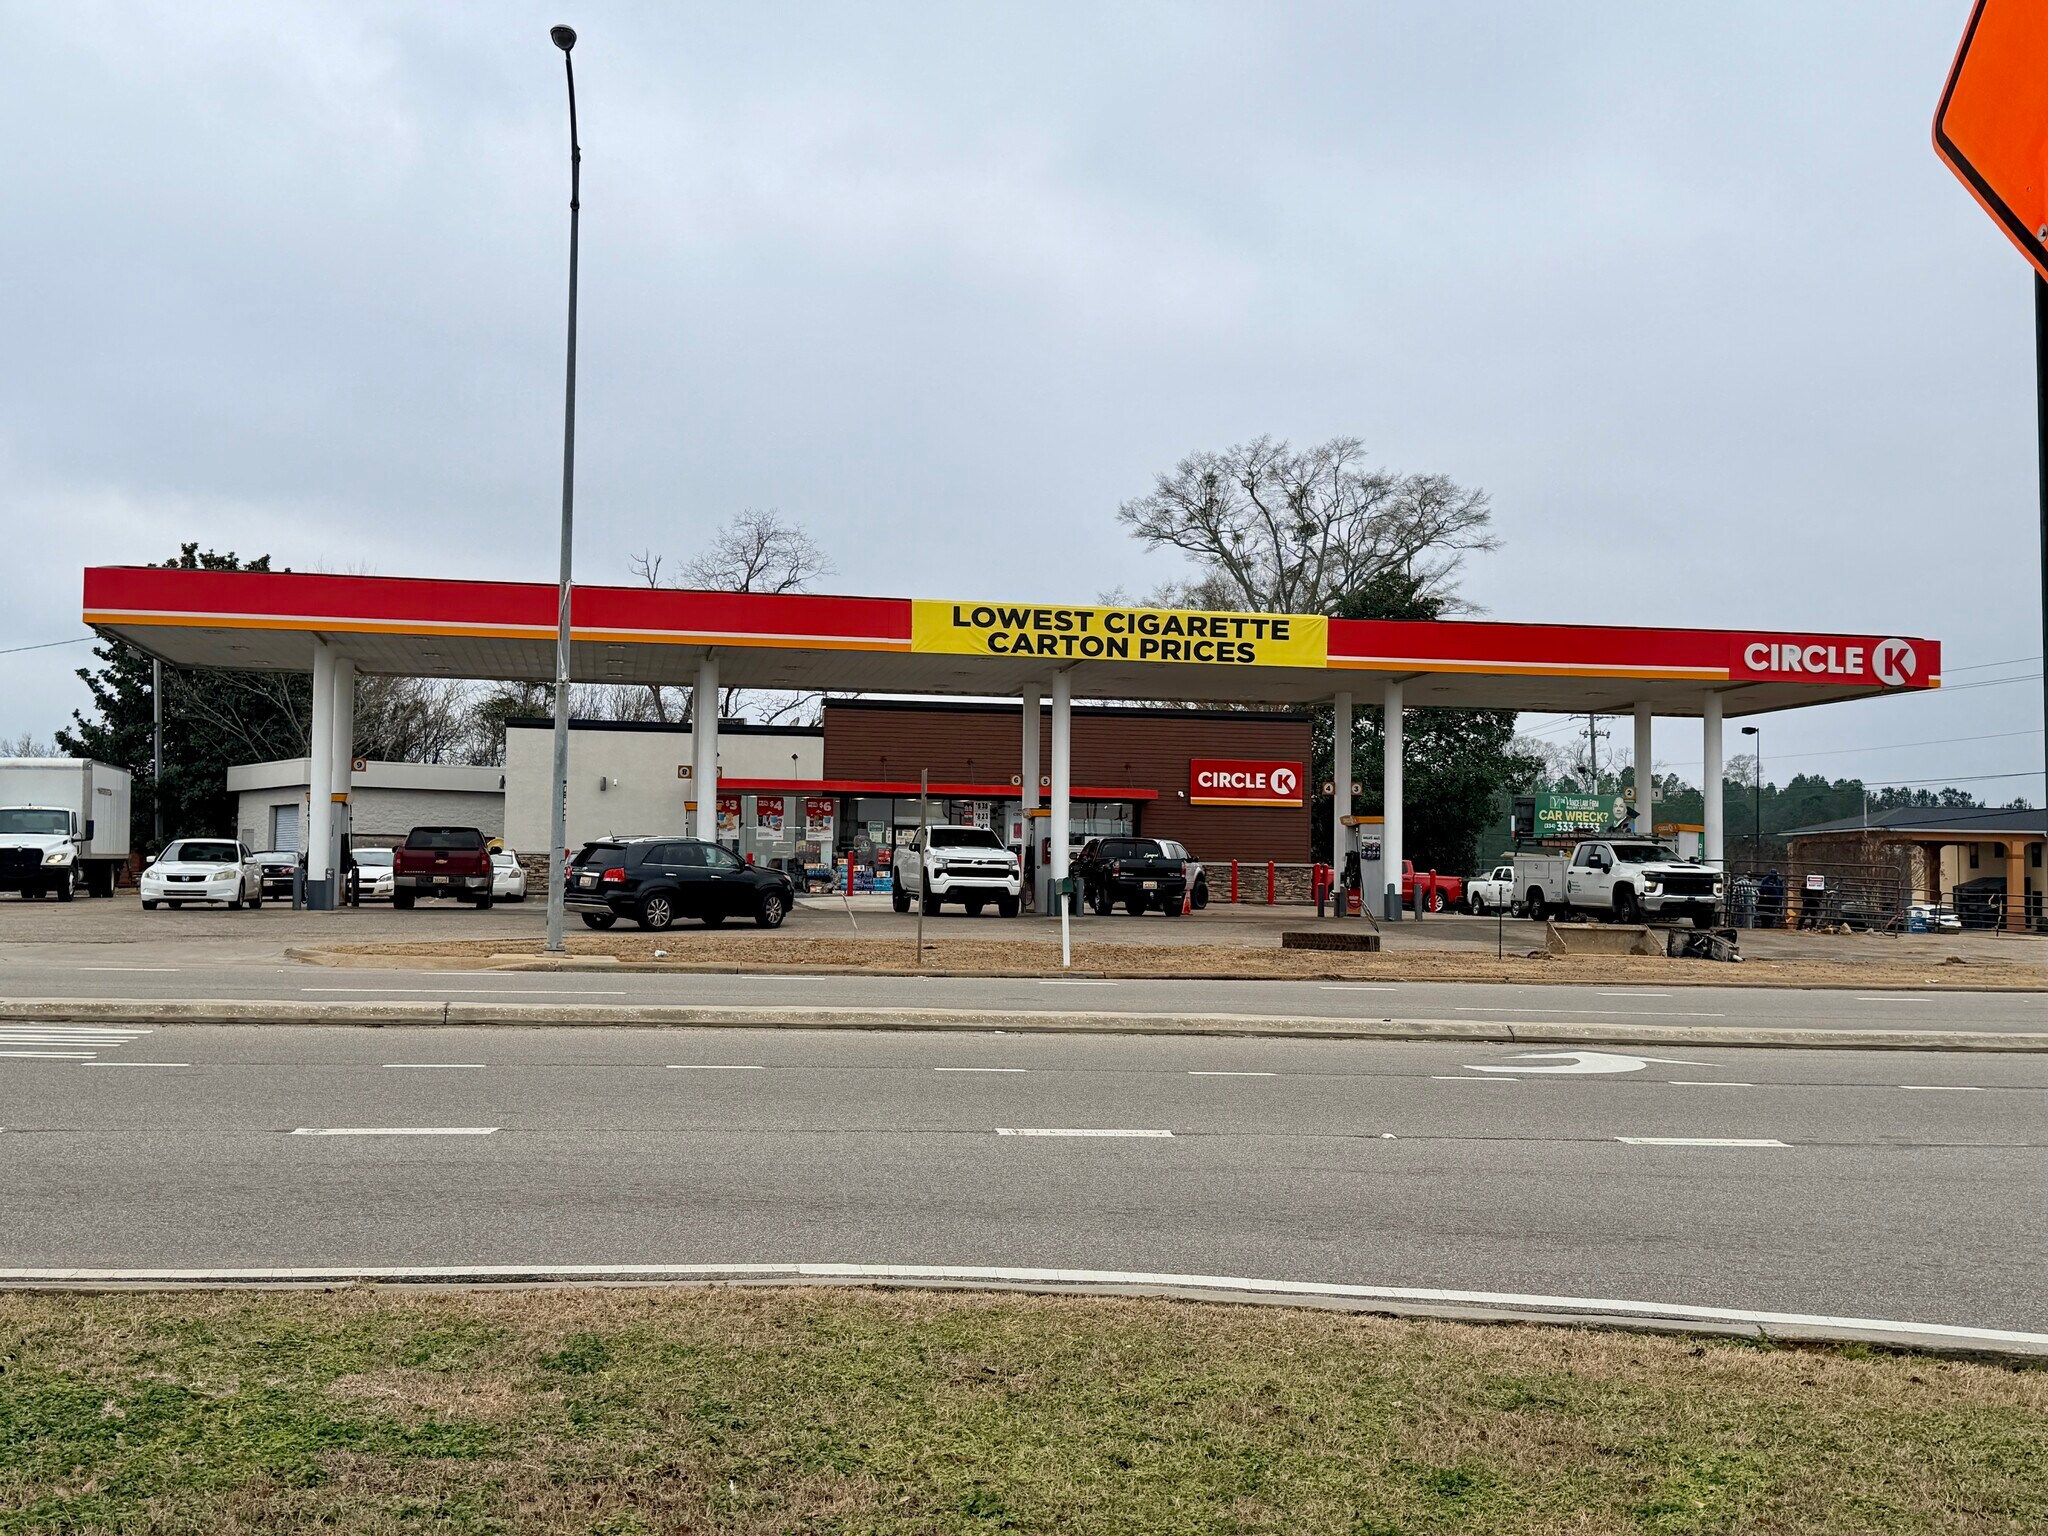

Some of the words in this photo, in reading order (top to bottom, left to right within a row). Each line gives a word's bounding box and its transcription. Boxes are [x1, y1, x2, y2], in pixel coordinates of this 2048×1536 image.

[952, 605, 1095, 632] LOWEST
[1104, 612, 1290, 641] CIGARETTE
[987, 632, 1129, 658] CARTON
[1139, 639, 1256, 664] PRICES
[1744, 642, 1864, 675] CIRCLE
[1878, 642, 1914, 686] K
[1198, 771, 1267, 789] CIRCLE
[1274, 771, 1294, 794] K
[1539, 810, 1563, 821] CAR
[1565, 810, 1609, 823] WRECK?
